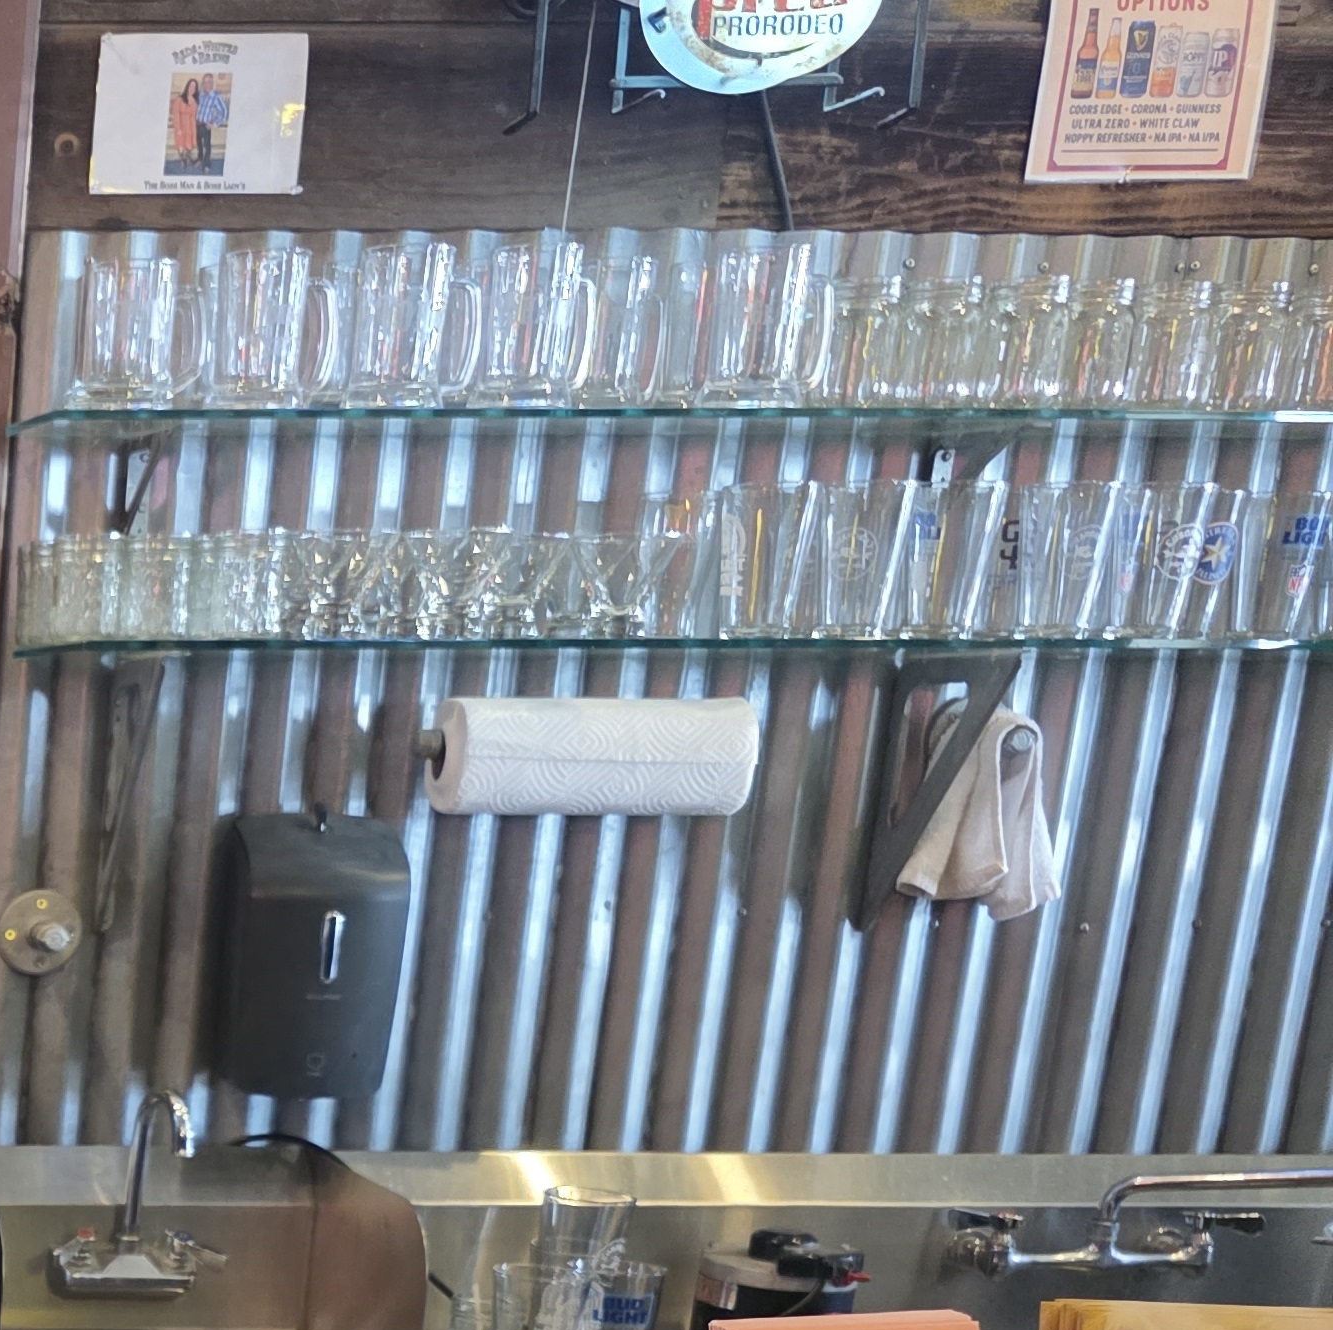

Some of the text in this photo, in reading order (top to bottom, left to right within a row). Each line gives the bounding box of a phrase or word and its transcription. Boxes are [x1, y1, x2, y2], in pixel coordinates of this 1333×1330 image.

[712, 12, 844, 36] PRORODEO
[1069, 103, 1222, 115] COORS EDGE CORONA GUINNESS
[1071, 117, 1200, 129] ULTRA ZERO WHITE CLAW
[1064, 132, 1094, 143] HOPPY
[1096, 132, 1146, 143] REFRESHER
[592, 1309, 649, 1324] LIGHT
